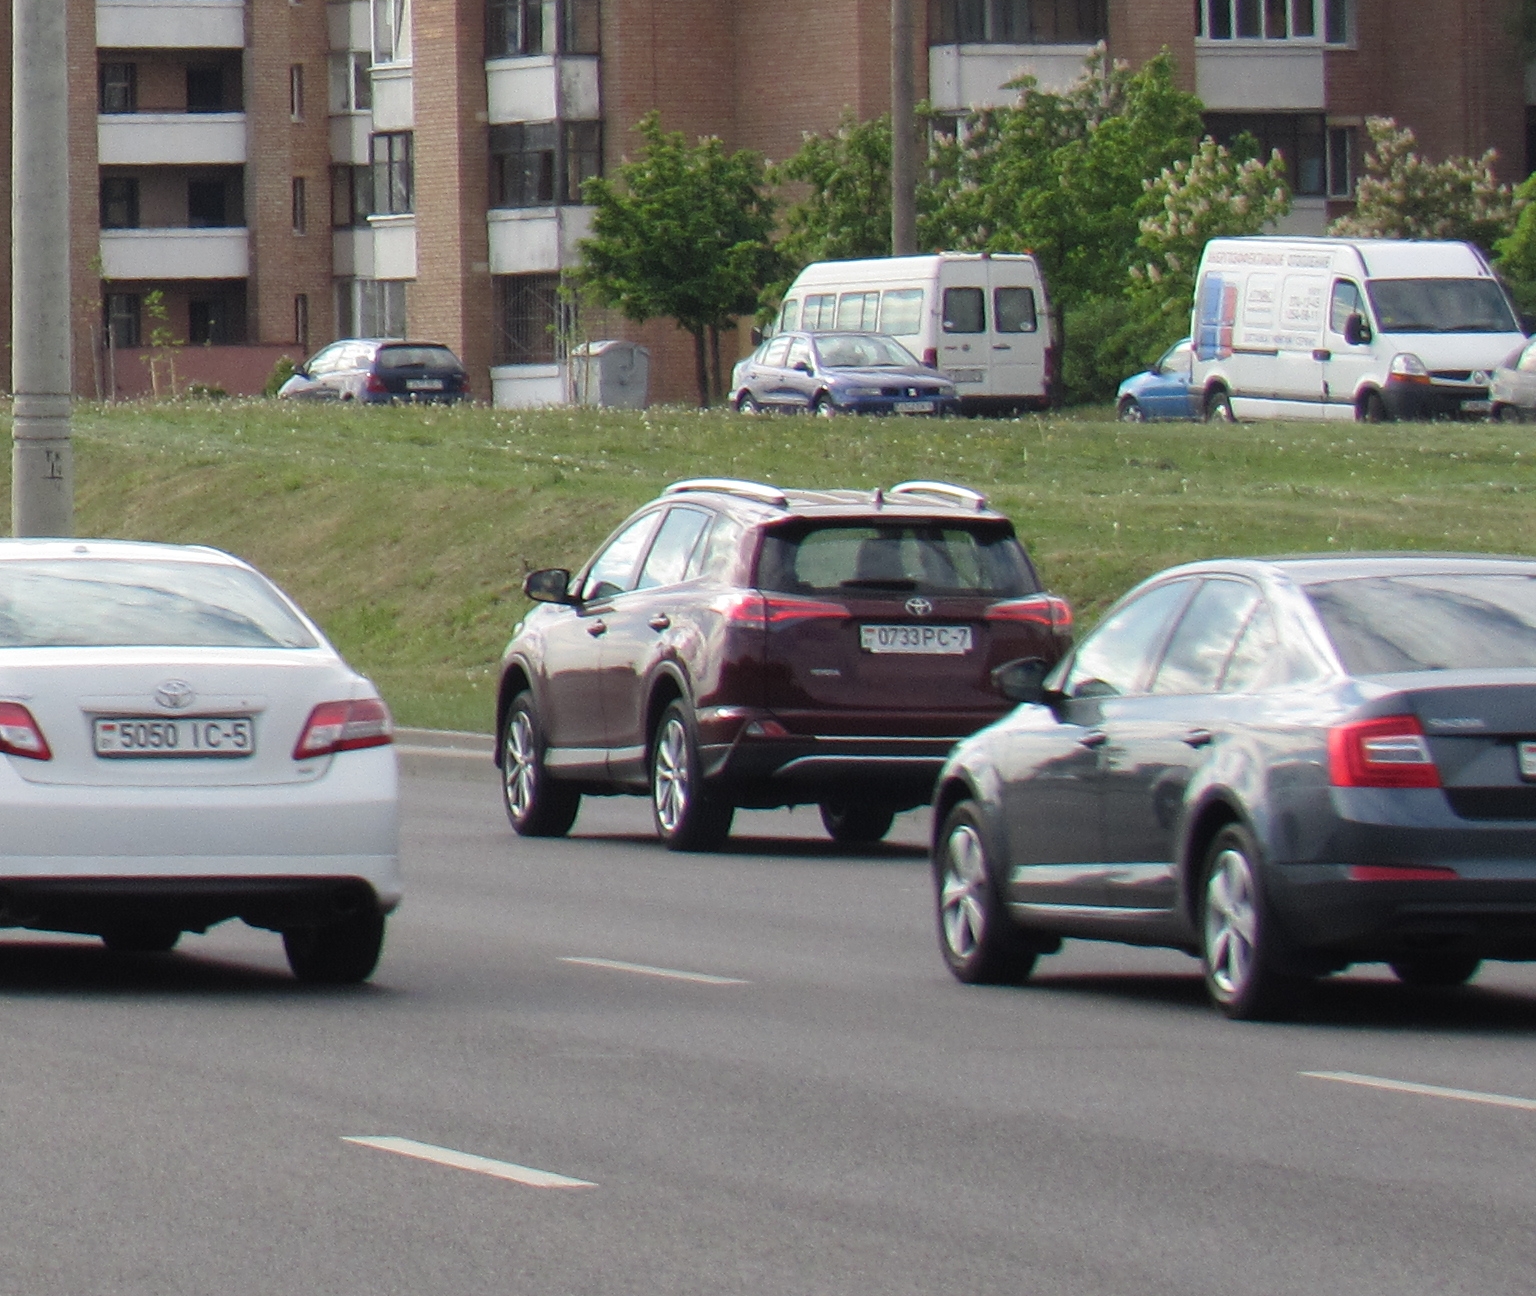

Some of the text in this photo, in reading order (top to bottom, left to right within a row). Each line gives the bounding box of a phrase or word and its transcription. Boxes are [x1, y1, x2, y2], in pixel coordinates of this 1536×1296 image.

[878, 628, 968, 647] 0733 PC-7
[119, 722, 248, 748] 5050 IC-5
